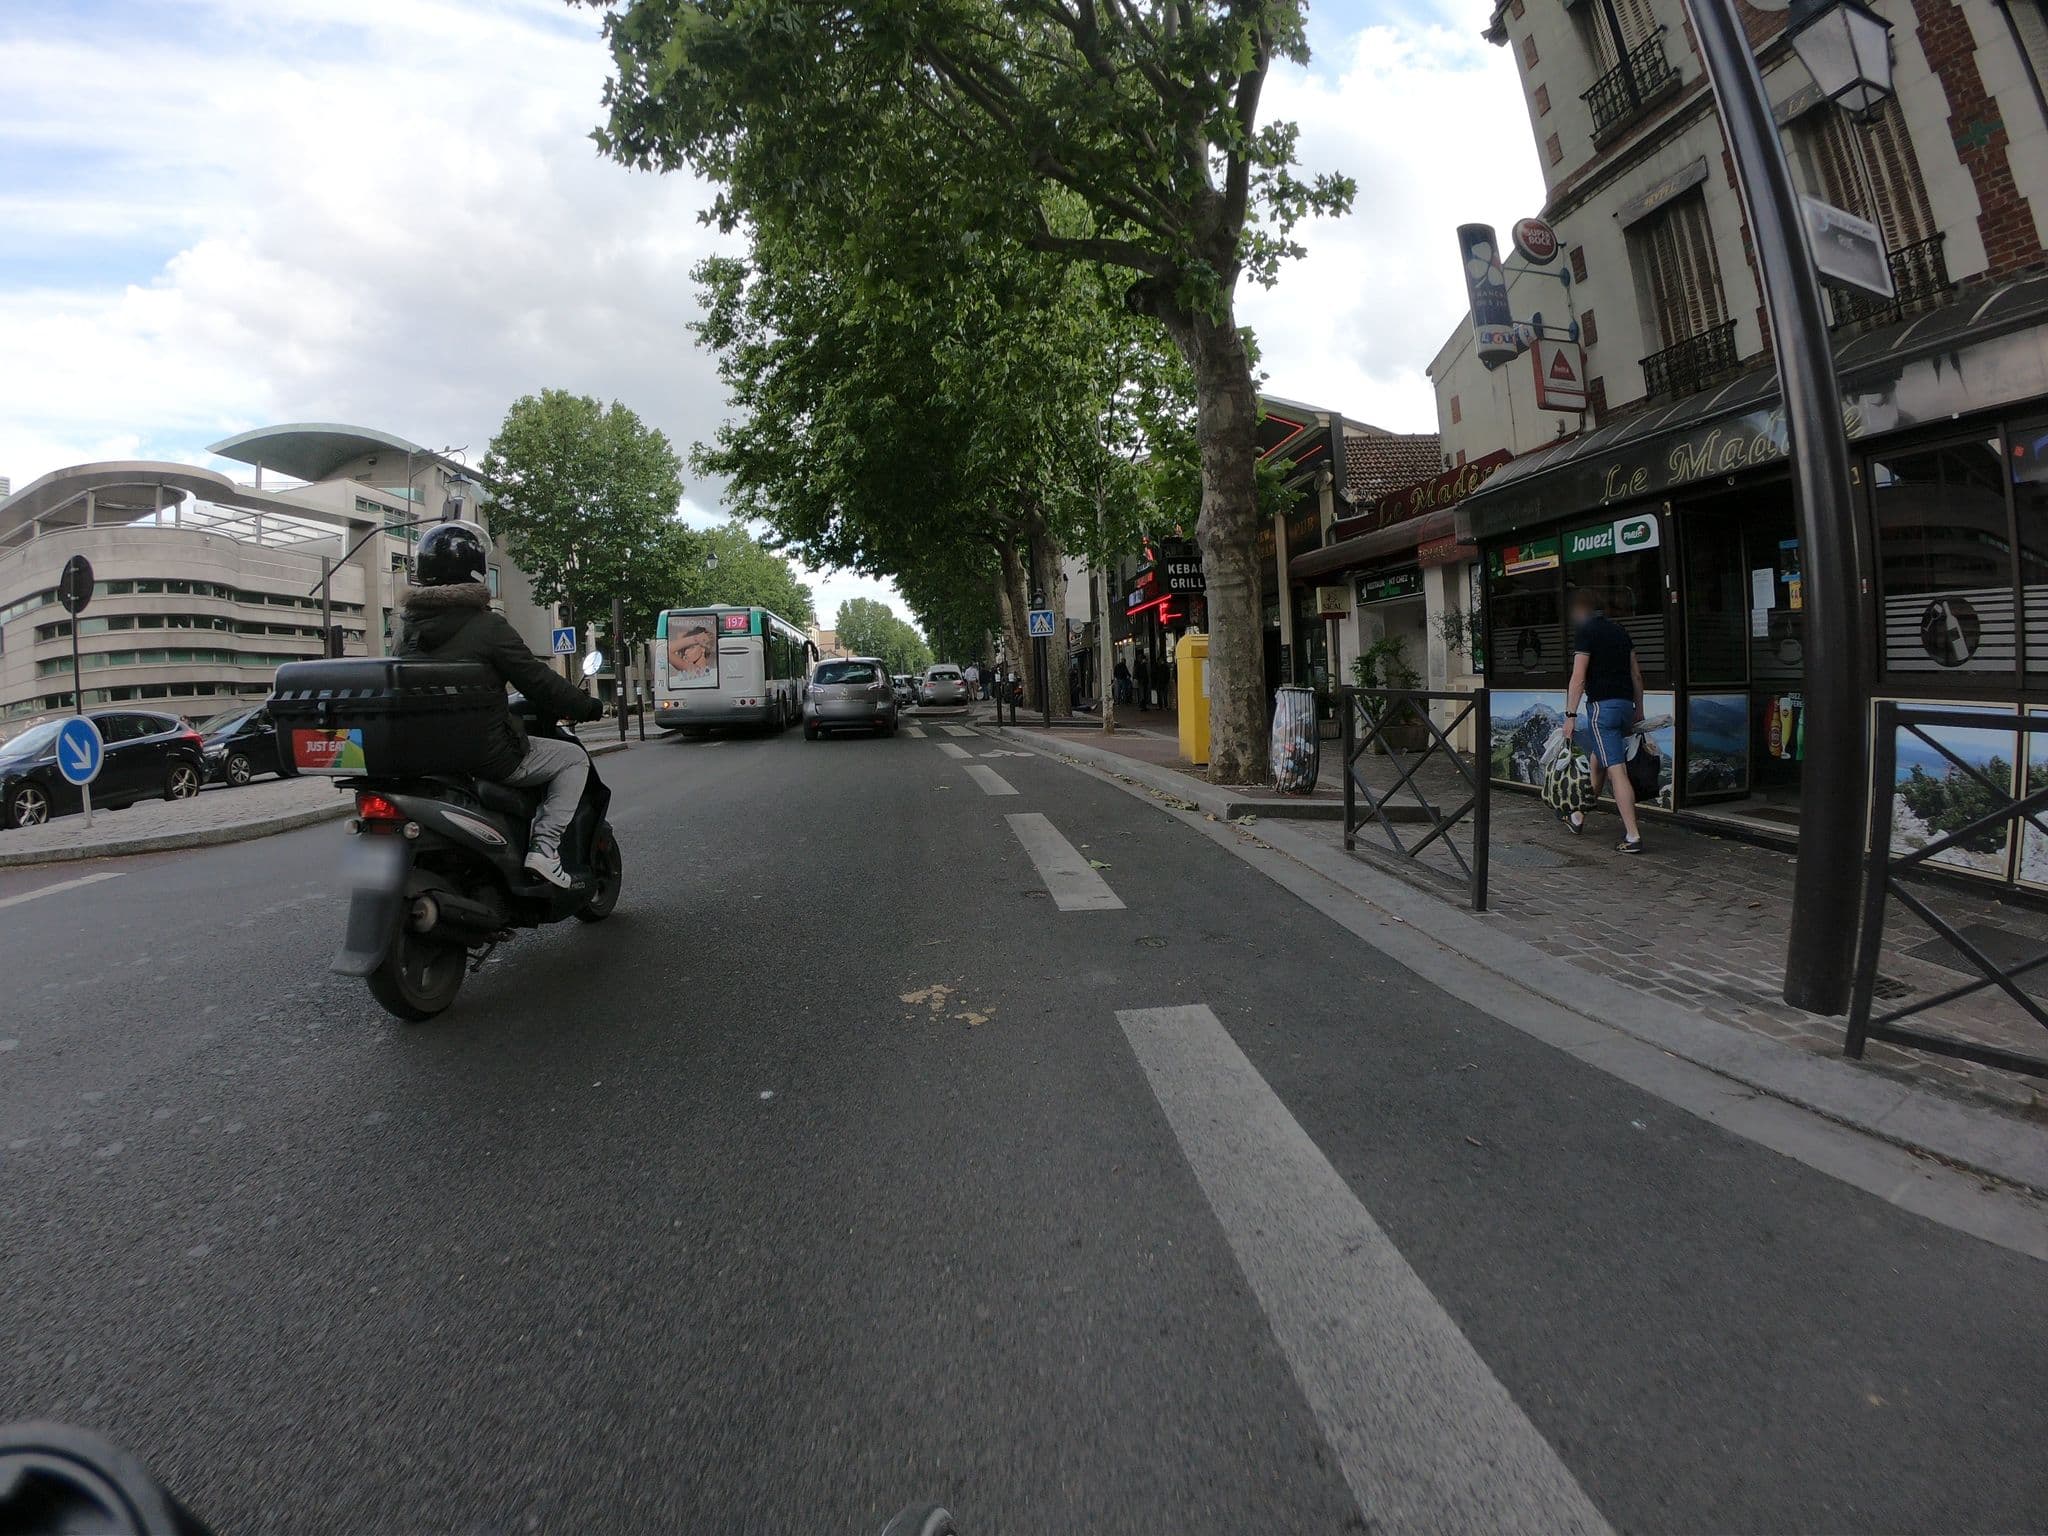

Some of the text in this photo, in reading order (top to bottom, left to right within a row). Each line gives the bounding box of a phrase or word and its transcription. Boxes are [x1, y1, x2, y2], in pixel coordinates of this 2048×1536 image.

[1526, 228, 1551, 240] SUPER
[1528, 235, 1552, 248] BOCK
[1600, 463, 1649, 506] Le
[1376, 499, 1404, 529] Le
[1572, 528, 1613, 553] Jouez!
[1170, 577, 1205, 589] GRILL
[727, 617, 744, 629] 197
[306, 740, 346, 753] JUST EAT
